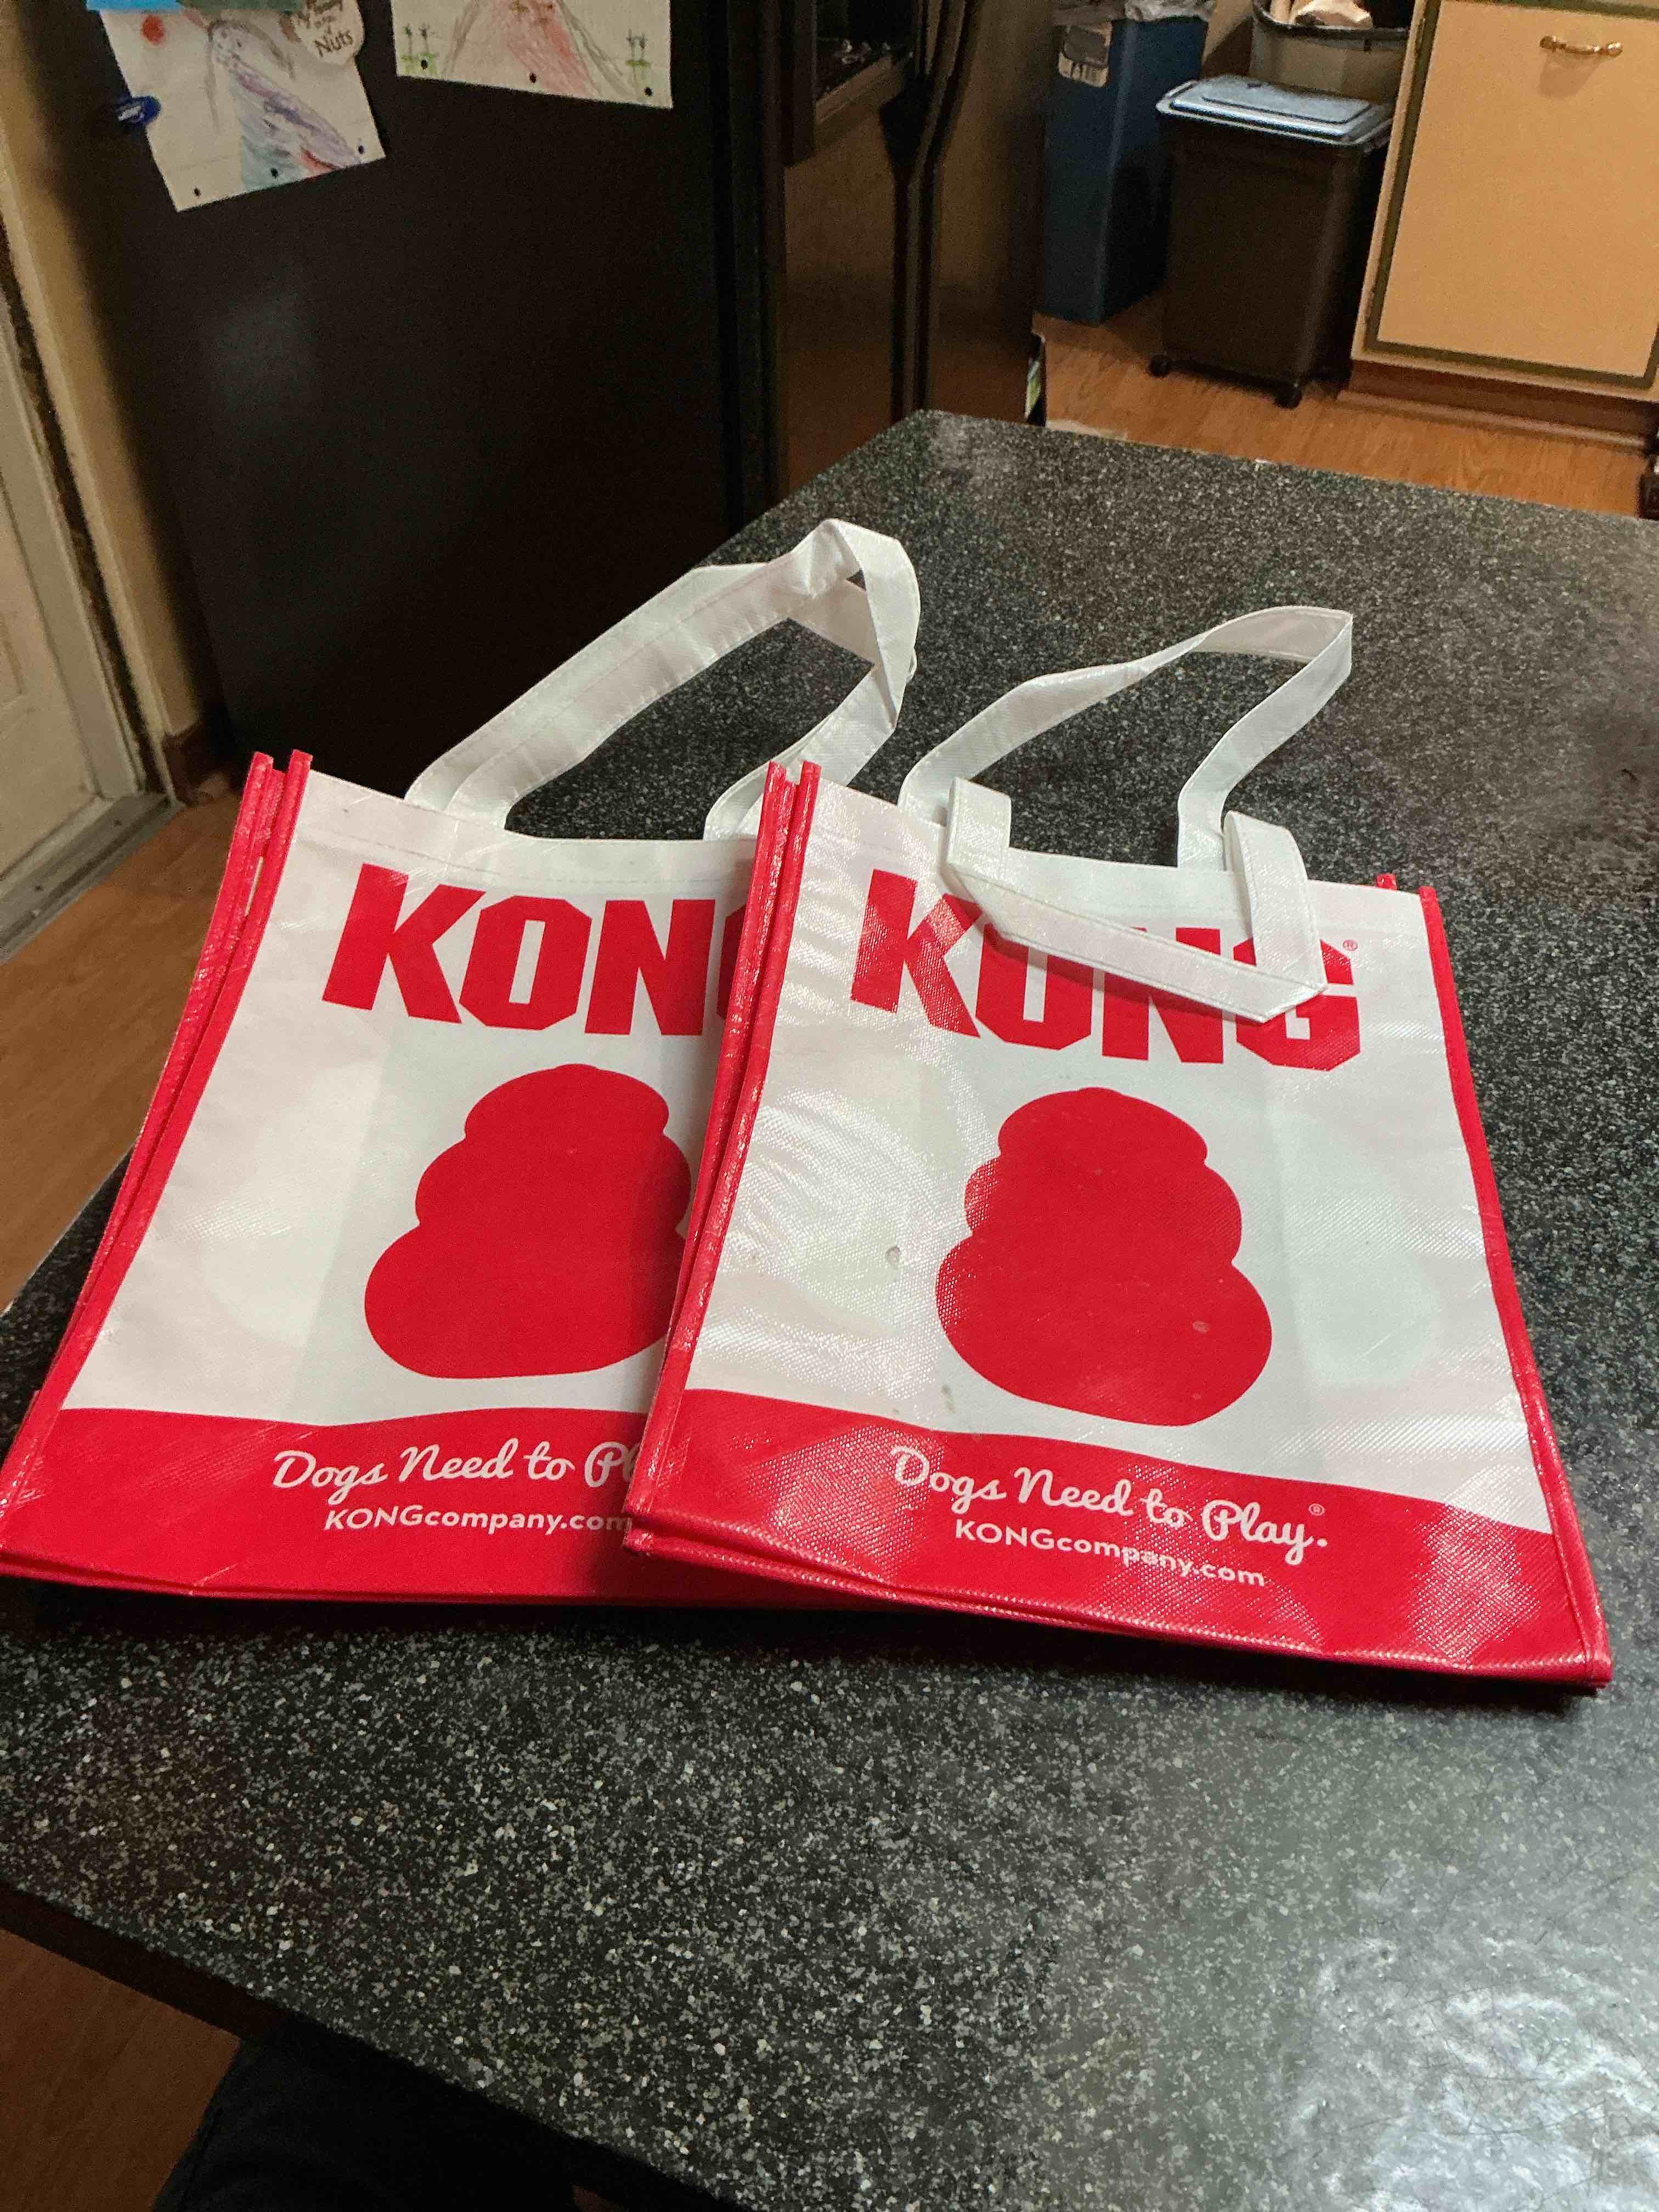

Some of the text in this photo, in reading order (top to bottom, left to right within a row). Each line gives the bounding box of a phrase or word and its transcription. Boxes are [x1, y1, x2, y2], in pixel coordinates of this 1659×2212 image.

[321, 863, 754, 1036] KON
[273, 1449, 388, 1505] Dogs
[398, 1437, 519, 1482] Need
[523, 1441, 575, 1481] to
[890, 1445, 1007, 1514] Dogs
[1014, 1467, 1134, 1516] Need
[1140, 1488, 1193, 1528] to
[955, 1518, 1265, 1587] KONGcompany.com
